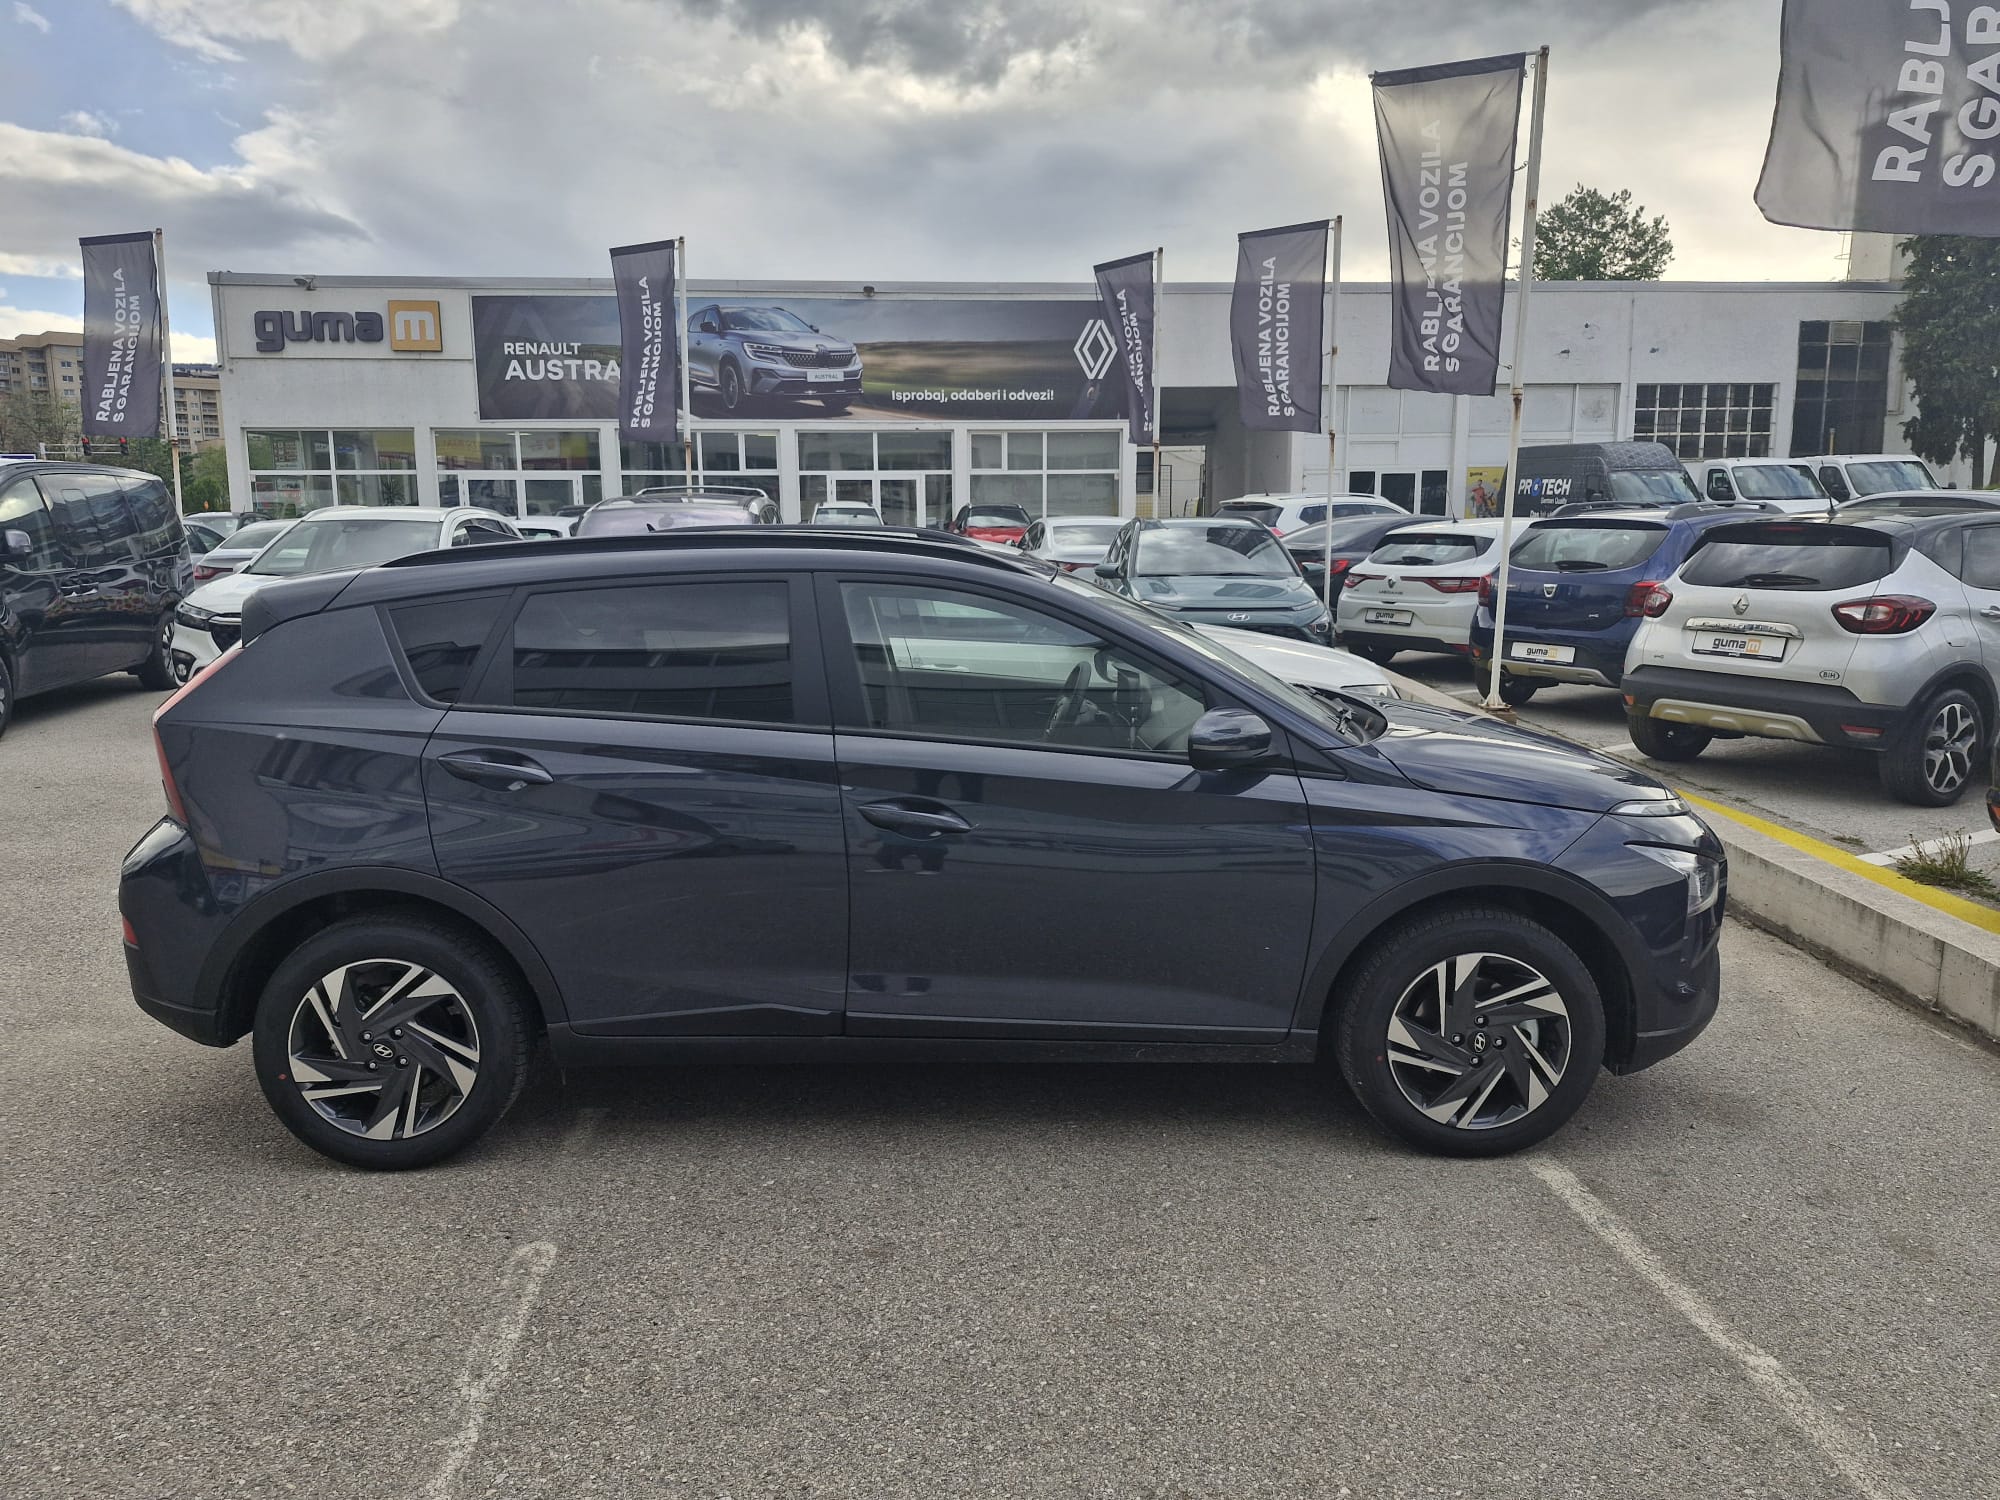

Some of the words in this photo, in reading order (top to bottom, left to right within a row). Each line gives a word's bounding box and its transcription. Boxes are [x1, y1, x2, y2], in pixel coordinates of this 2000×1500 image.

[1418, 119, 1442, 231] VOZILA
[1942, 153, 1996, 188] S
[1442, 161, 1468, 353] GARANCIJOM
[638, 275, 653, 343] VOZILA
[1258, 256, 1277, 327] VOZILA
[96, 336, 125, 422] RABLJENA
[112, 267, 127, 336] VOZILA
[254, 310, 384, 352] guma
[503, 342, 581, 355] RENAULT
[1275, 282, 1293, 404] GARANCIJOM
[116, 295, 141, 410] GARANCIJOM
[643, 301, 662, 416] GARANCIJOM
[1445, 358, 1460, 373] S
[630, 343, 652, 428] RABLJENA
[1258, 327, 1281, 417] RABLJENA
[891, 389, 949, 404] Isprobaj,
[950, 389, 1001, 402] odaberi
[1008, 389, 1054, 402] odvezi!
[1283, 406, 1296, 417] S
[113, 411, 125, 423] S
[641, 419, 651, 428] S
[1517, 478, 1572, 497] PROTECH
[1375, 611, 1395, 620] guma
[1526, 647, 1549, 656] guma
[1712, 637, 1747, 650] guma
